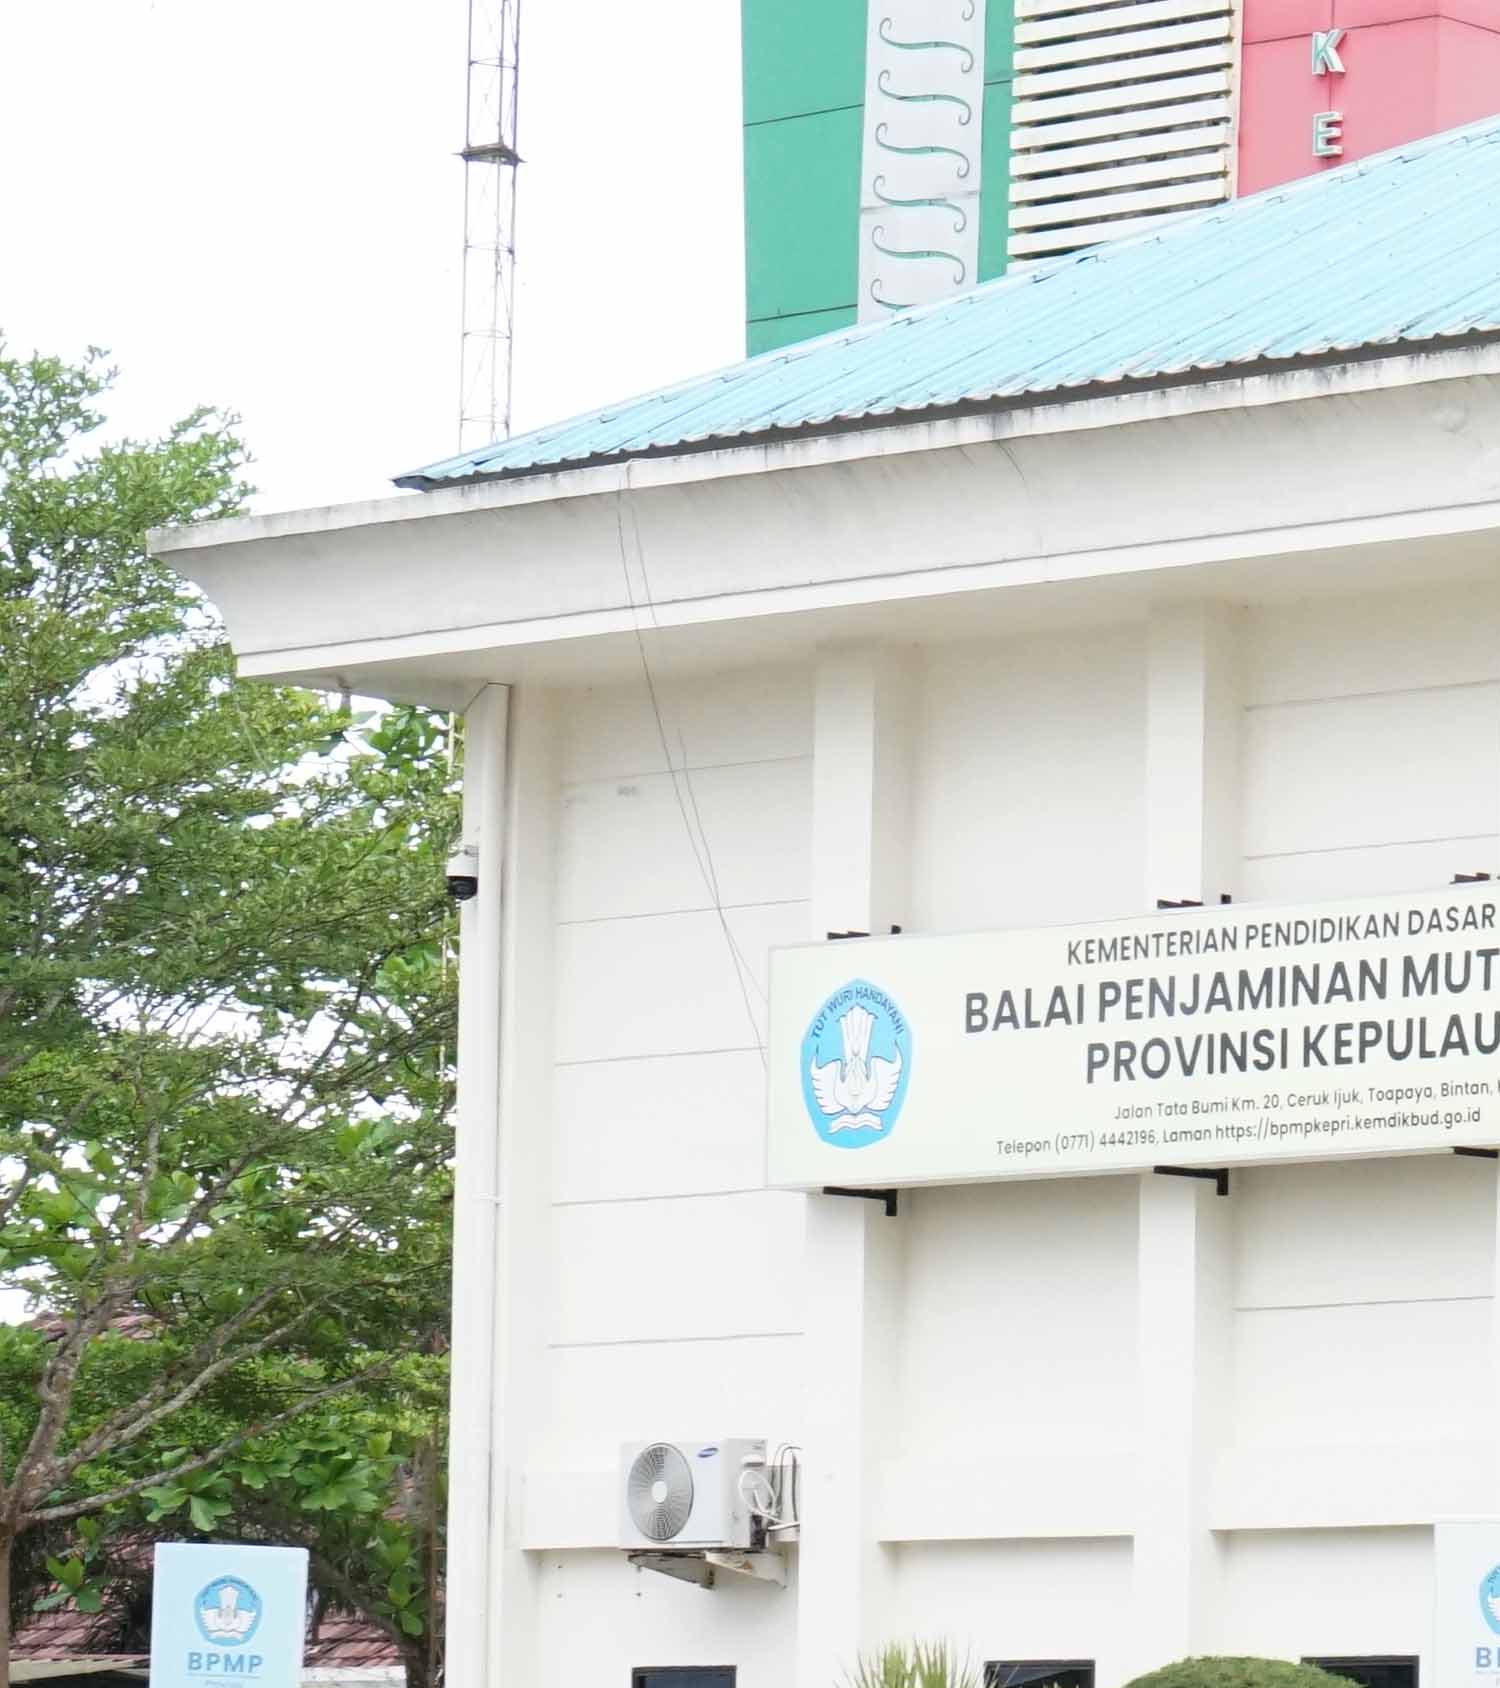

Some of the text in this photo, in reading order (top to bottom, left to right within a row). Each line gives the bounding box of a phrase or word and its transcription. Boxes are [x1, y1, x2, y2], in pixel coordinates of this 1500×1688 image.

[1068, 926, 1237, 965] KEMENTERIAN
[1246, 911, 1399, 950] PENDIDIKAN
[1409, 903, 1496, 935] DASAR
[965, 983, 1084, 1033] BALAI
[1099, 958, 1387, 1022] PENJAMINAN
[1087, 1027, 1287, 1084] PROVINSI
[1114, 1104, 1153, 1120] Jalan
[1157, 1101, 1188, 1118] Tata
[1192, 1097, 1228, 1115] Bumi
[1232, 1096, 1260, 1112] Km.
[1263, 1094, 1283, 1111] 20,
[1287, 1090, 1329, 1108] Ceruk
[1368, 1085, 1437, 1107] Toapaya,
[1441, 1079, 1494, 1098] Bintan,
[997, 1137, 1051, 1157] Telepon
[1055, 1133, 1095, 1154] (0771)
[1099, 1129, 1160, 1149] 4442196,
[1162, 1125, 1211, 1144] Laman
[1215, 1107, 1481, 1141] https://bpmpkepri.kemdikbud.go.id
[187, 1652, 263, 1673] BPMP
